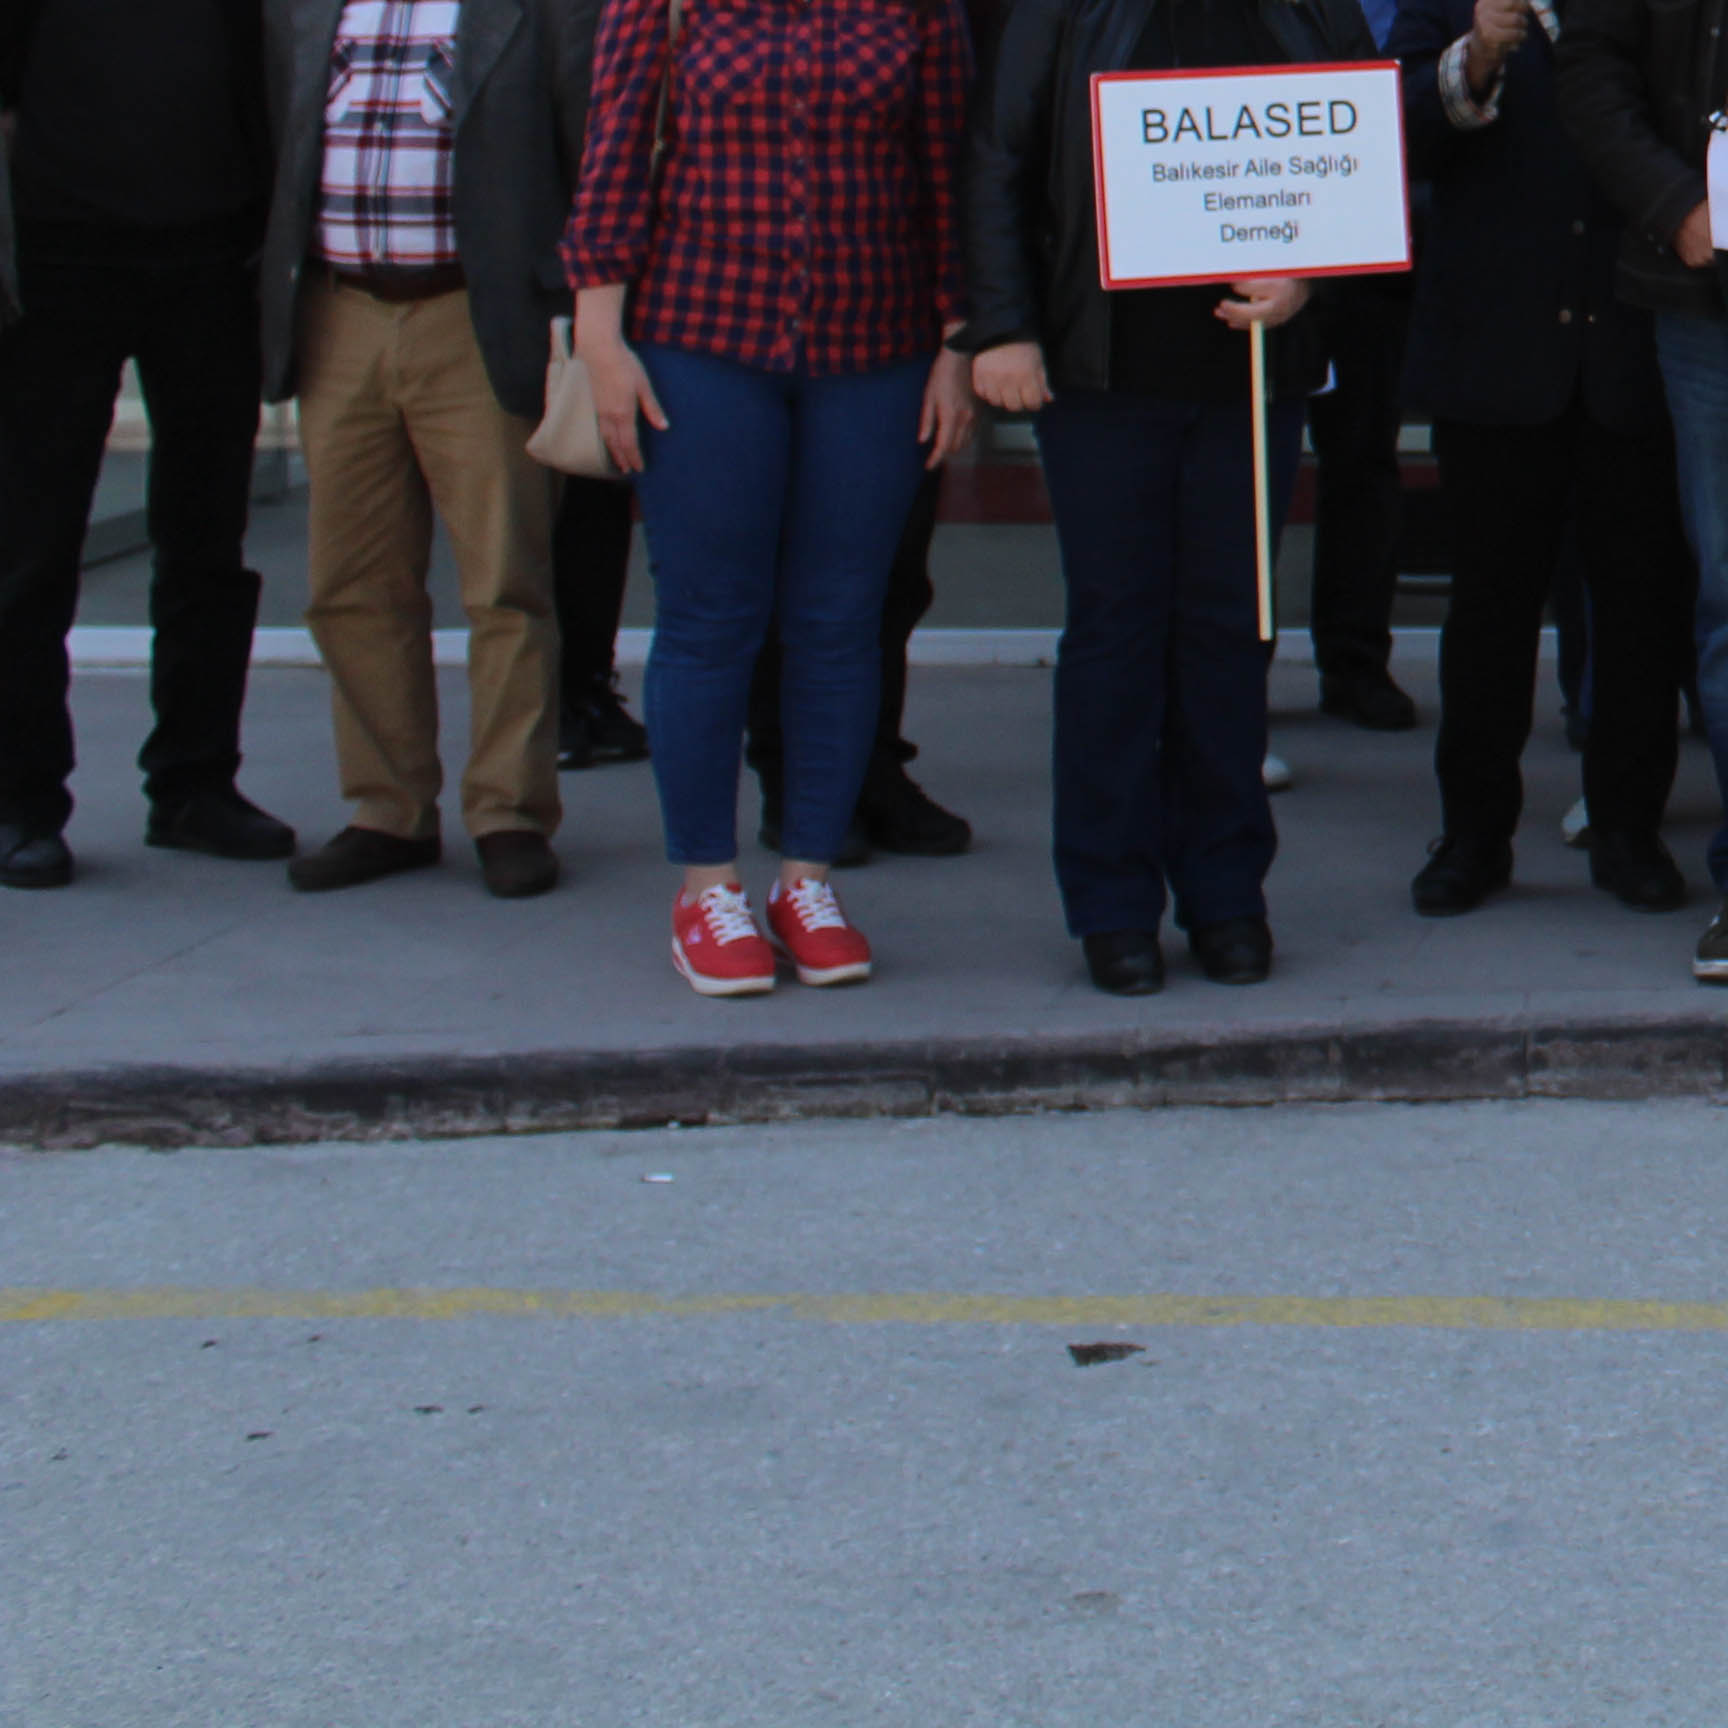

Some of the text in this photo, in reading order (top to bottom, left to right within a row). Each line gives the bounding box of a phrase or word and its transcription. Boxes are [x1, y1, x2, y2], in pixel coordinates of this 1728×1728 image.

[1140, 99, 1359, 144] BALASED
[1152, 153, 1358, 184] Balıkesir Aile Sağlığı
[1203, 189, 1312, 212] Elemanları
[1220, 220, 1299, 244] Derneği
